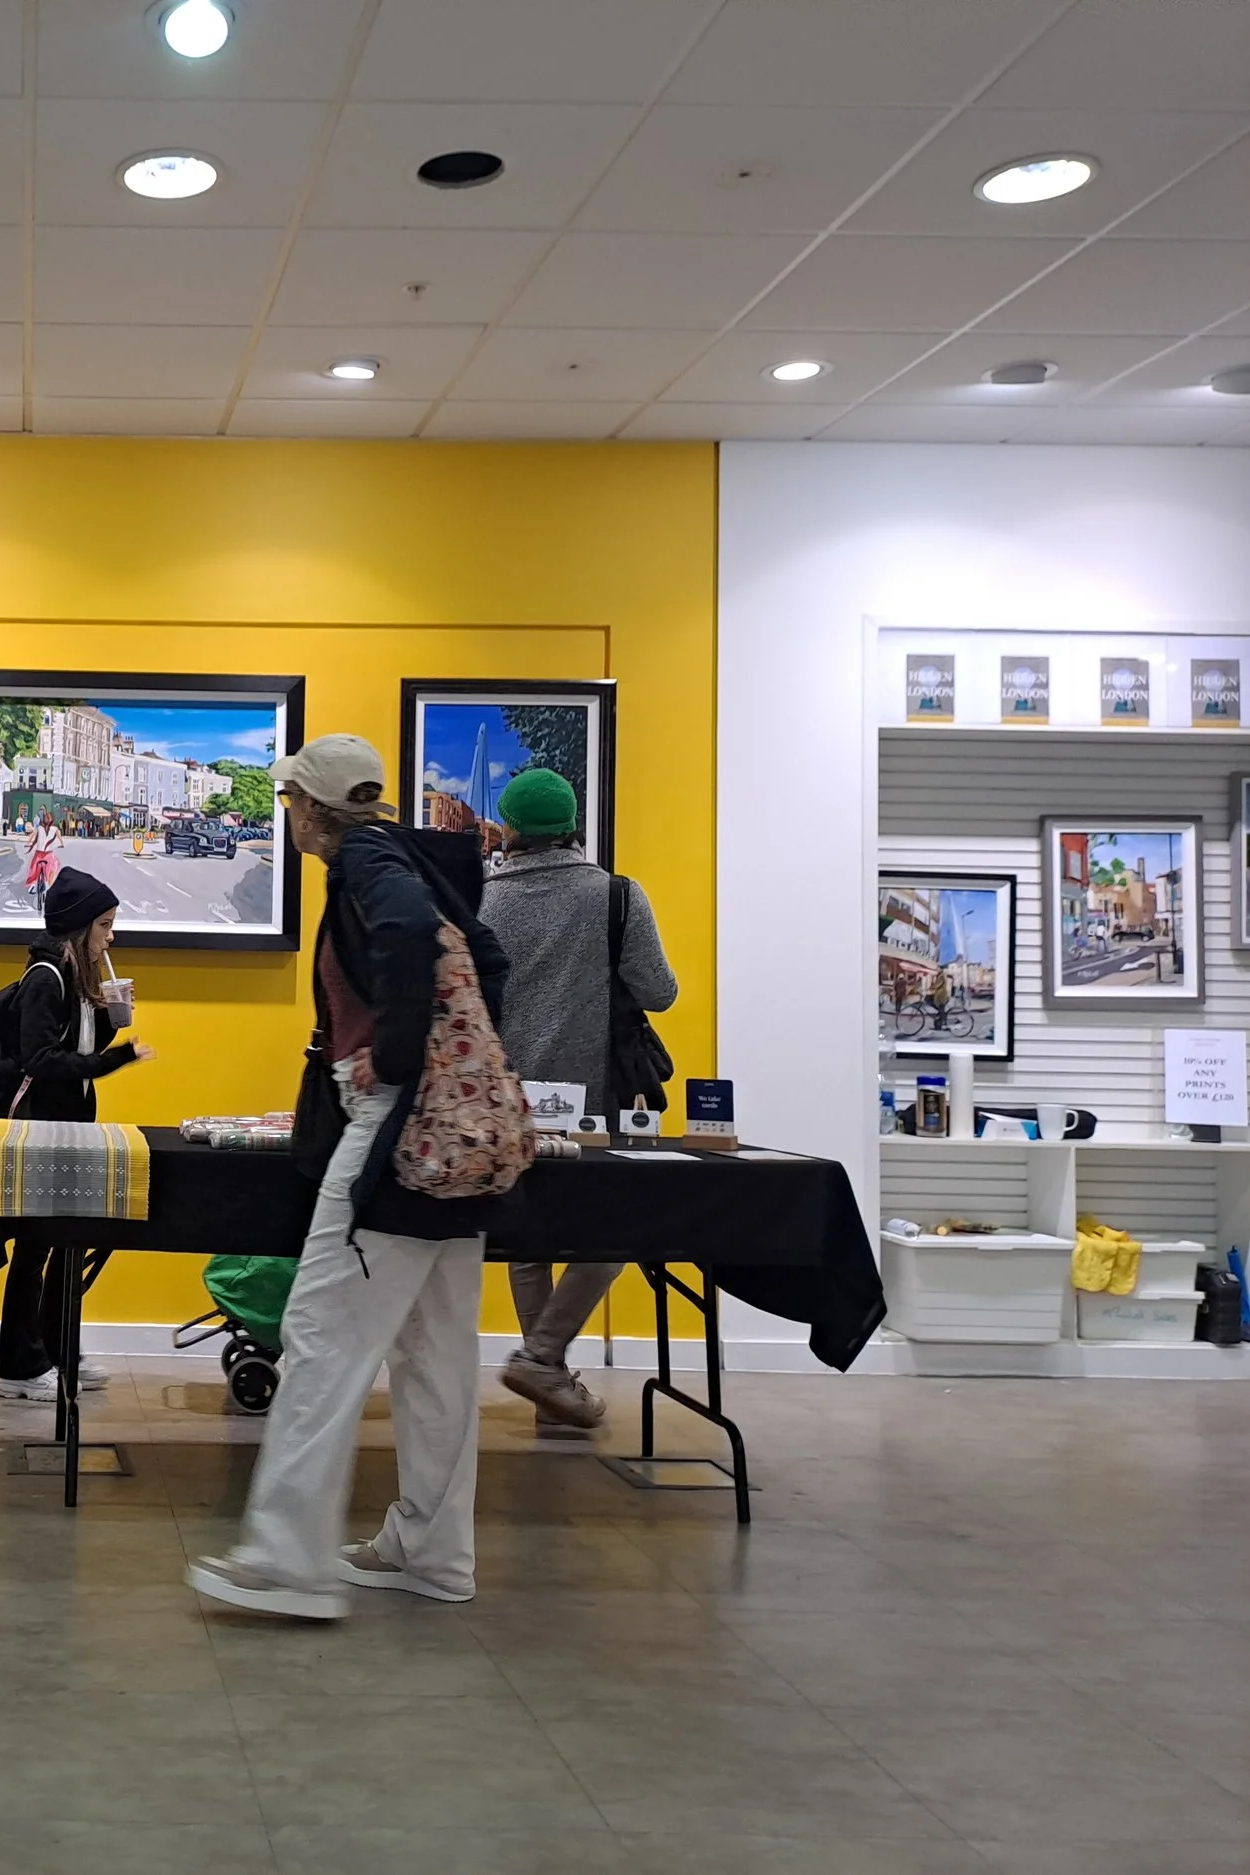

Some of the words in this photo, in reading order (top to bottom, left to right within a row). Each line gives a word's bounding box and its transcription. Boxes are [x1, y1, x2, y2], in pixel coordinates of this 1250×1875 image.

[907, 686, 954, 697] LONDON
[1002, 688, 1049, 699] LONDON
[1101, 689, 1148, 700] LONDON
[1193, 691, 1239, 702] LONDON
[1204, 1058, 1228, 1066] OFF
[1193, 1069, 1217, 1077] ANY
[1185, 1080, 1226, 1088] PRINTS
[1177, 1091, 1209, 1099] OVER
